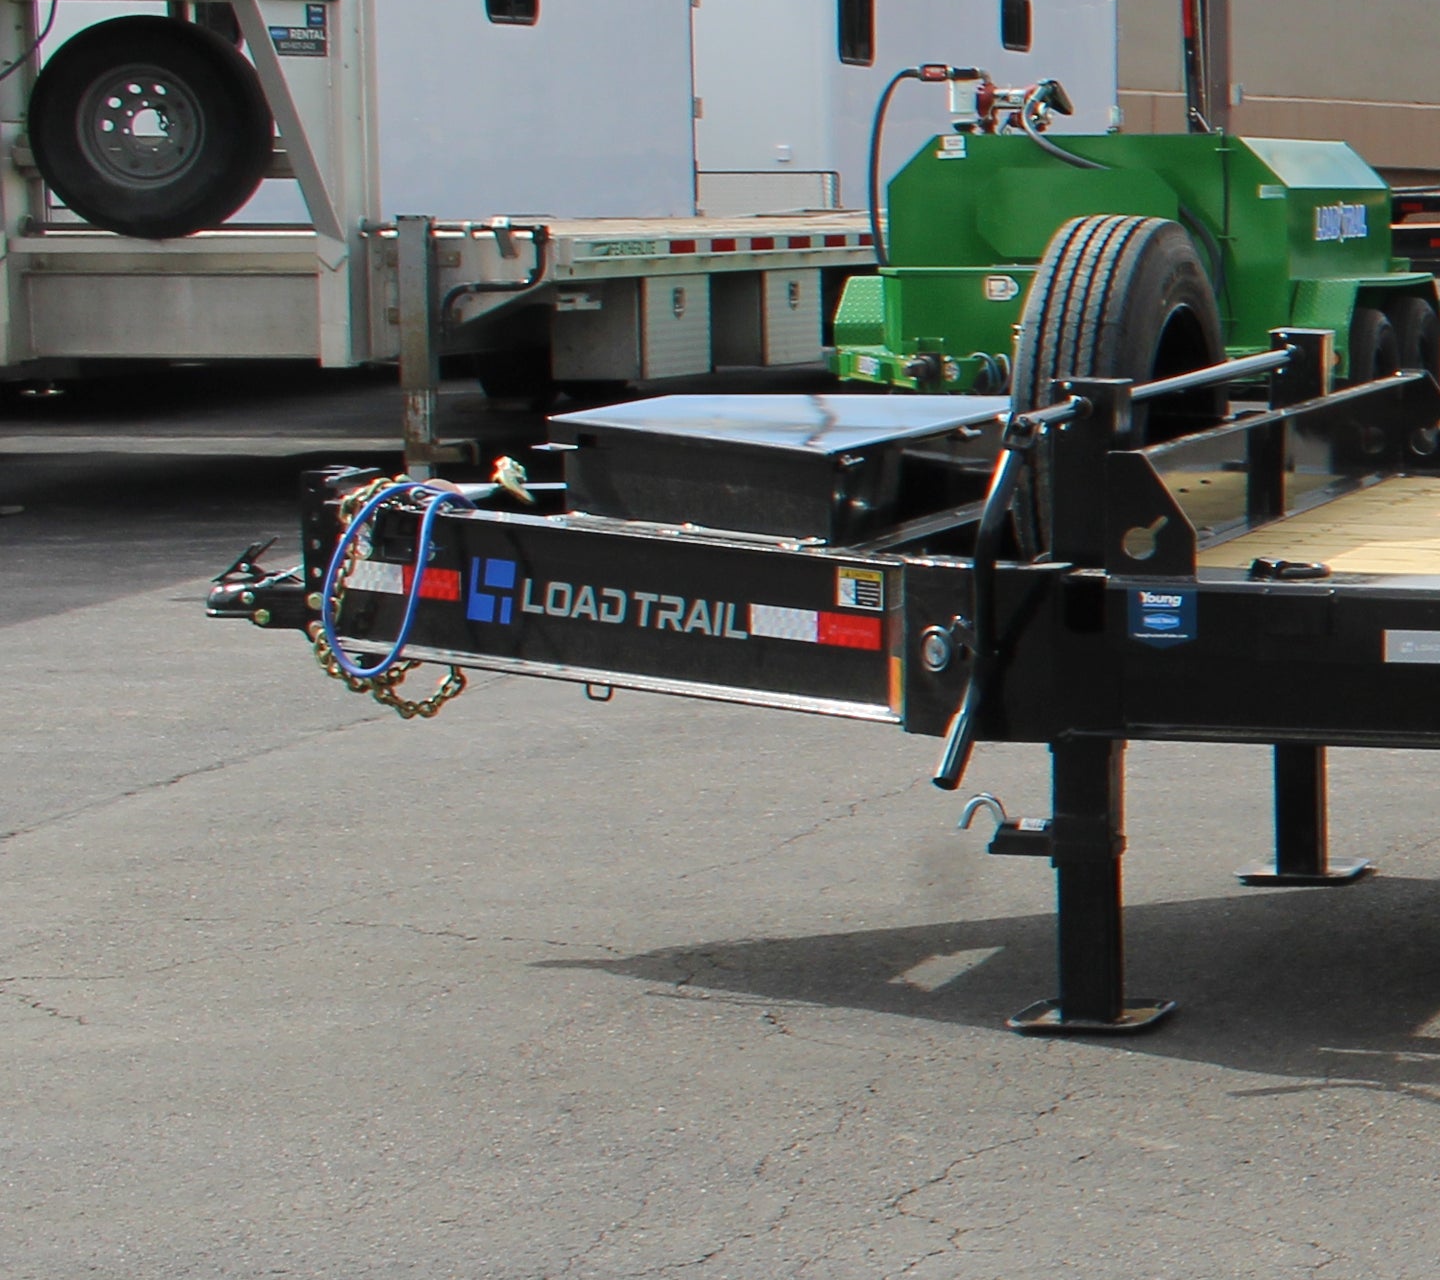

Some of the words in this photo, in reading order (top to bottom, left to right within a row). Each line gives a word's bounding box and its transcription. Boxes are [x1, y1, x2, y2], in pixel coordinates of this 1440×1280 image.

[290, 29, 326, 41] RENTAL
[1138, 591, 1183, 608] Young
[521, 577, 628, 624] LOAD
[633, 590, 749, 640] TRAIL
